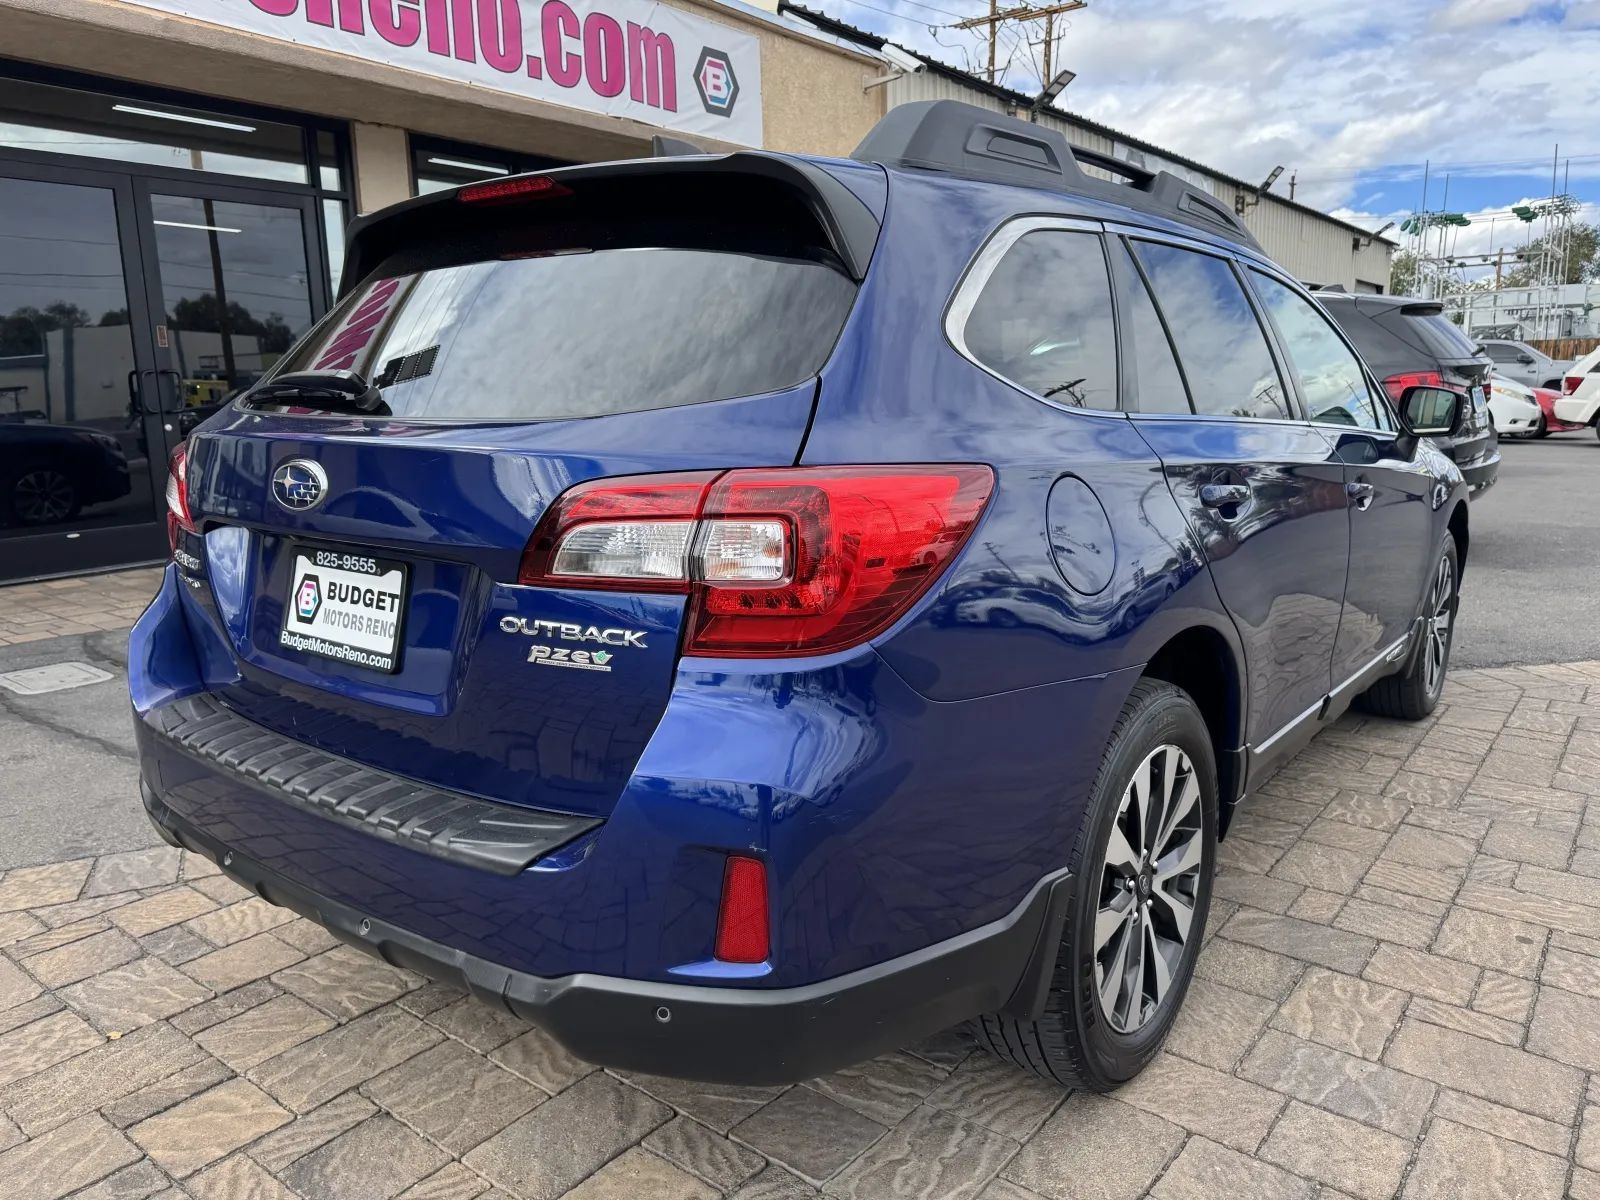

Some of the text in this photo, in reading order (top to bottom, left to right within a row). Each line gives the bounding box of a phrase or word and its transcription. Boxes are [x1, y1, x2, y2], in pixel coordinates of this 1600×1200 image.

[316, 551, 376, 573] 825-9555
[327, 581, 400, 613] BUDGET
[322, 607, 396, 639] MOTORS RENO
[500, 616, 648, 648] OUTBACK
[280, 630, 392, 670] BudgetMotorsReno.com
